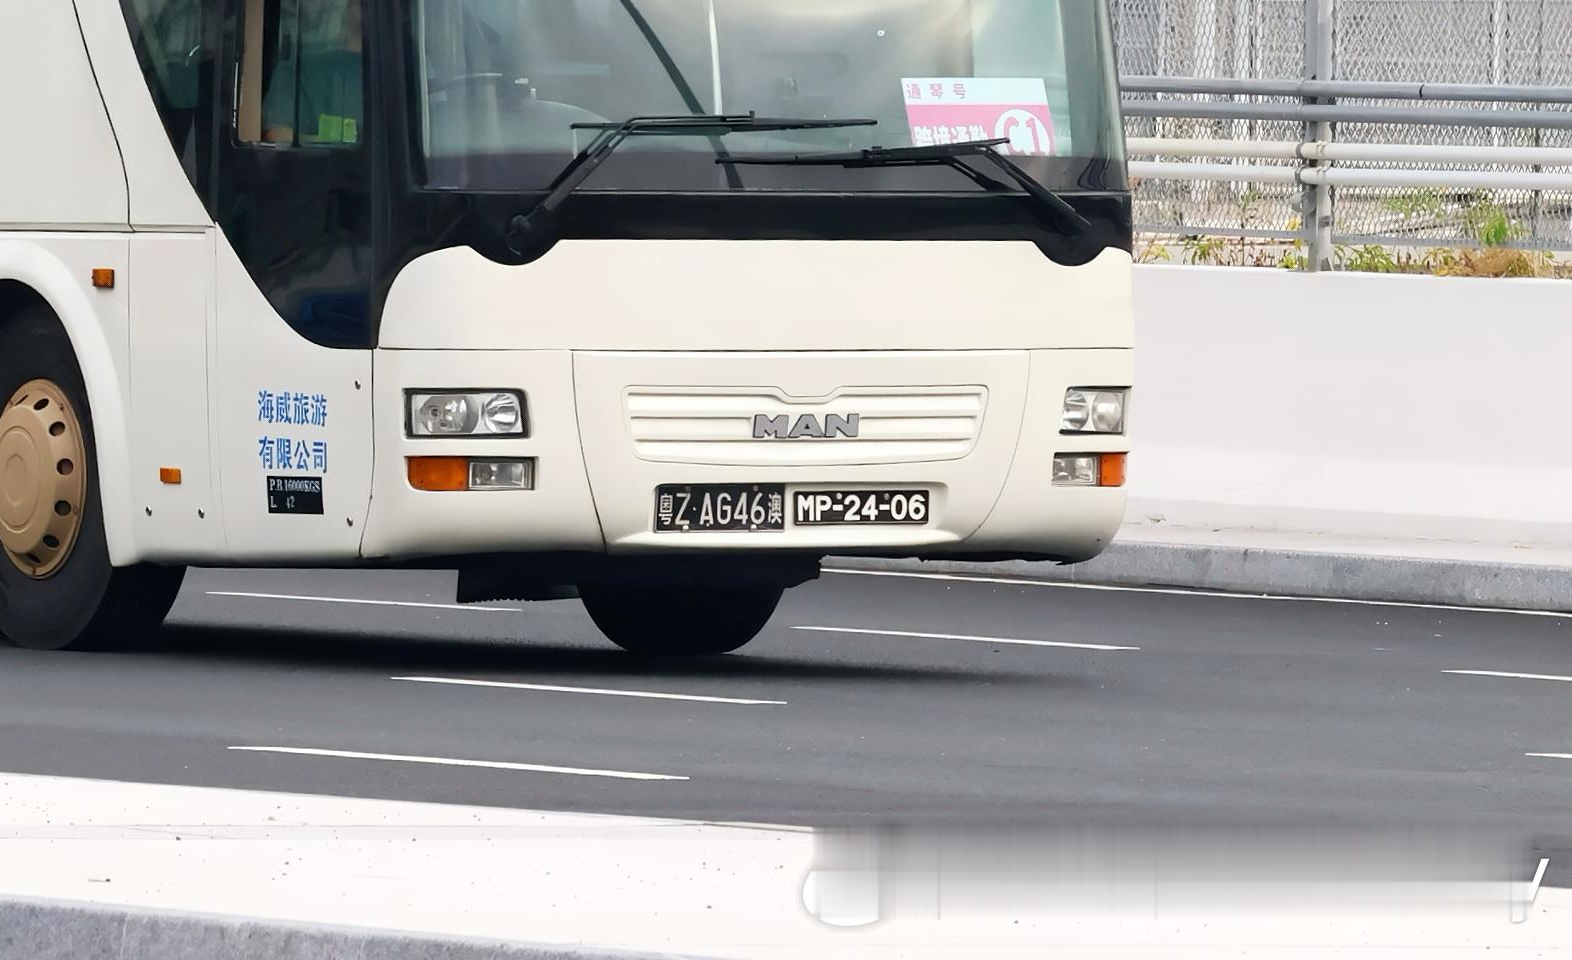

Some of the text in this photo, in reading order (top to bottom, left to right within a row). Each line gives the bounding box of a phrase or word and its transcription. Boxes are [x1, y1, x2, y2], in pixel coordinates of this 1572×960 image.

[906, 83, 966, 100] 通琴号
[258, 390, 328, 427] 海威旅游
[752, 413, 860, 438] MAN
[258, 436, 328, 474] 有限公司
[797, 493, 927, 522] MP-24-06
